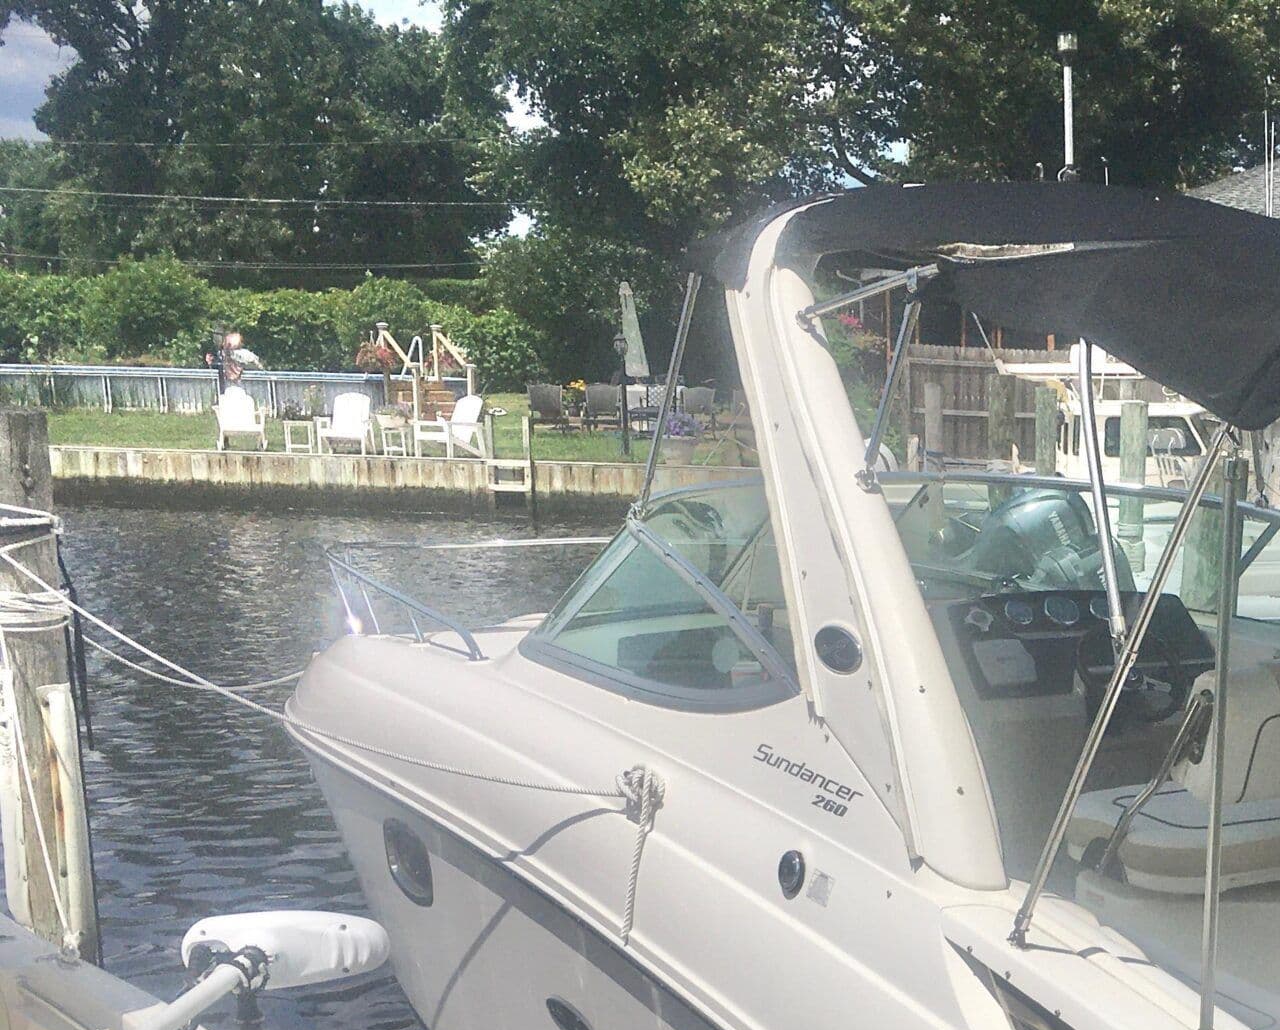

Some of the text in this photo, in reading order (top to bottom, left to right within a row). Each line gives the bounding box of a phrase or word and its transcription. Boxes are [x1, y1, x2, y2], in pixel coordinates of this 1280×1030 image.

[1048, 510, 1071, 546] YAMAHA
[753, 743, 864, 802] Sundancer
[811, 794, 849, 817] 260
